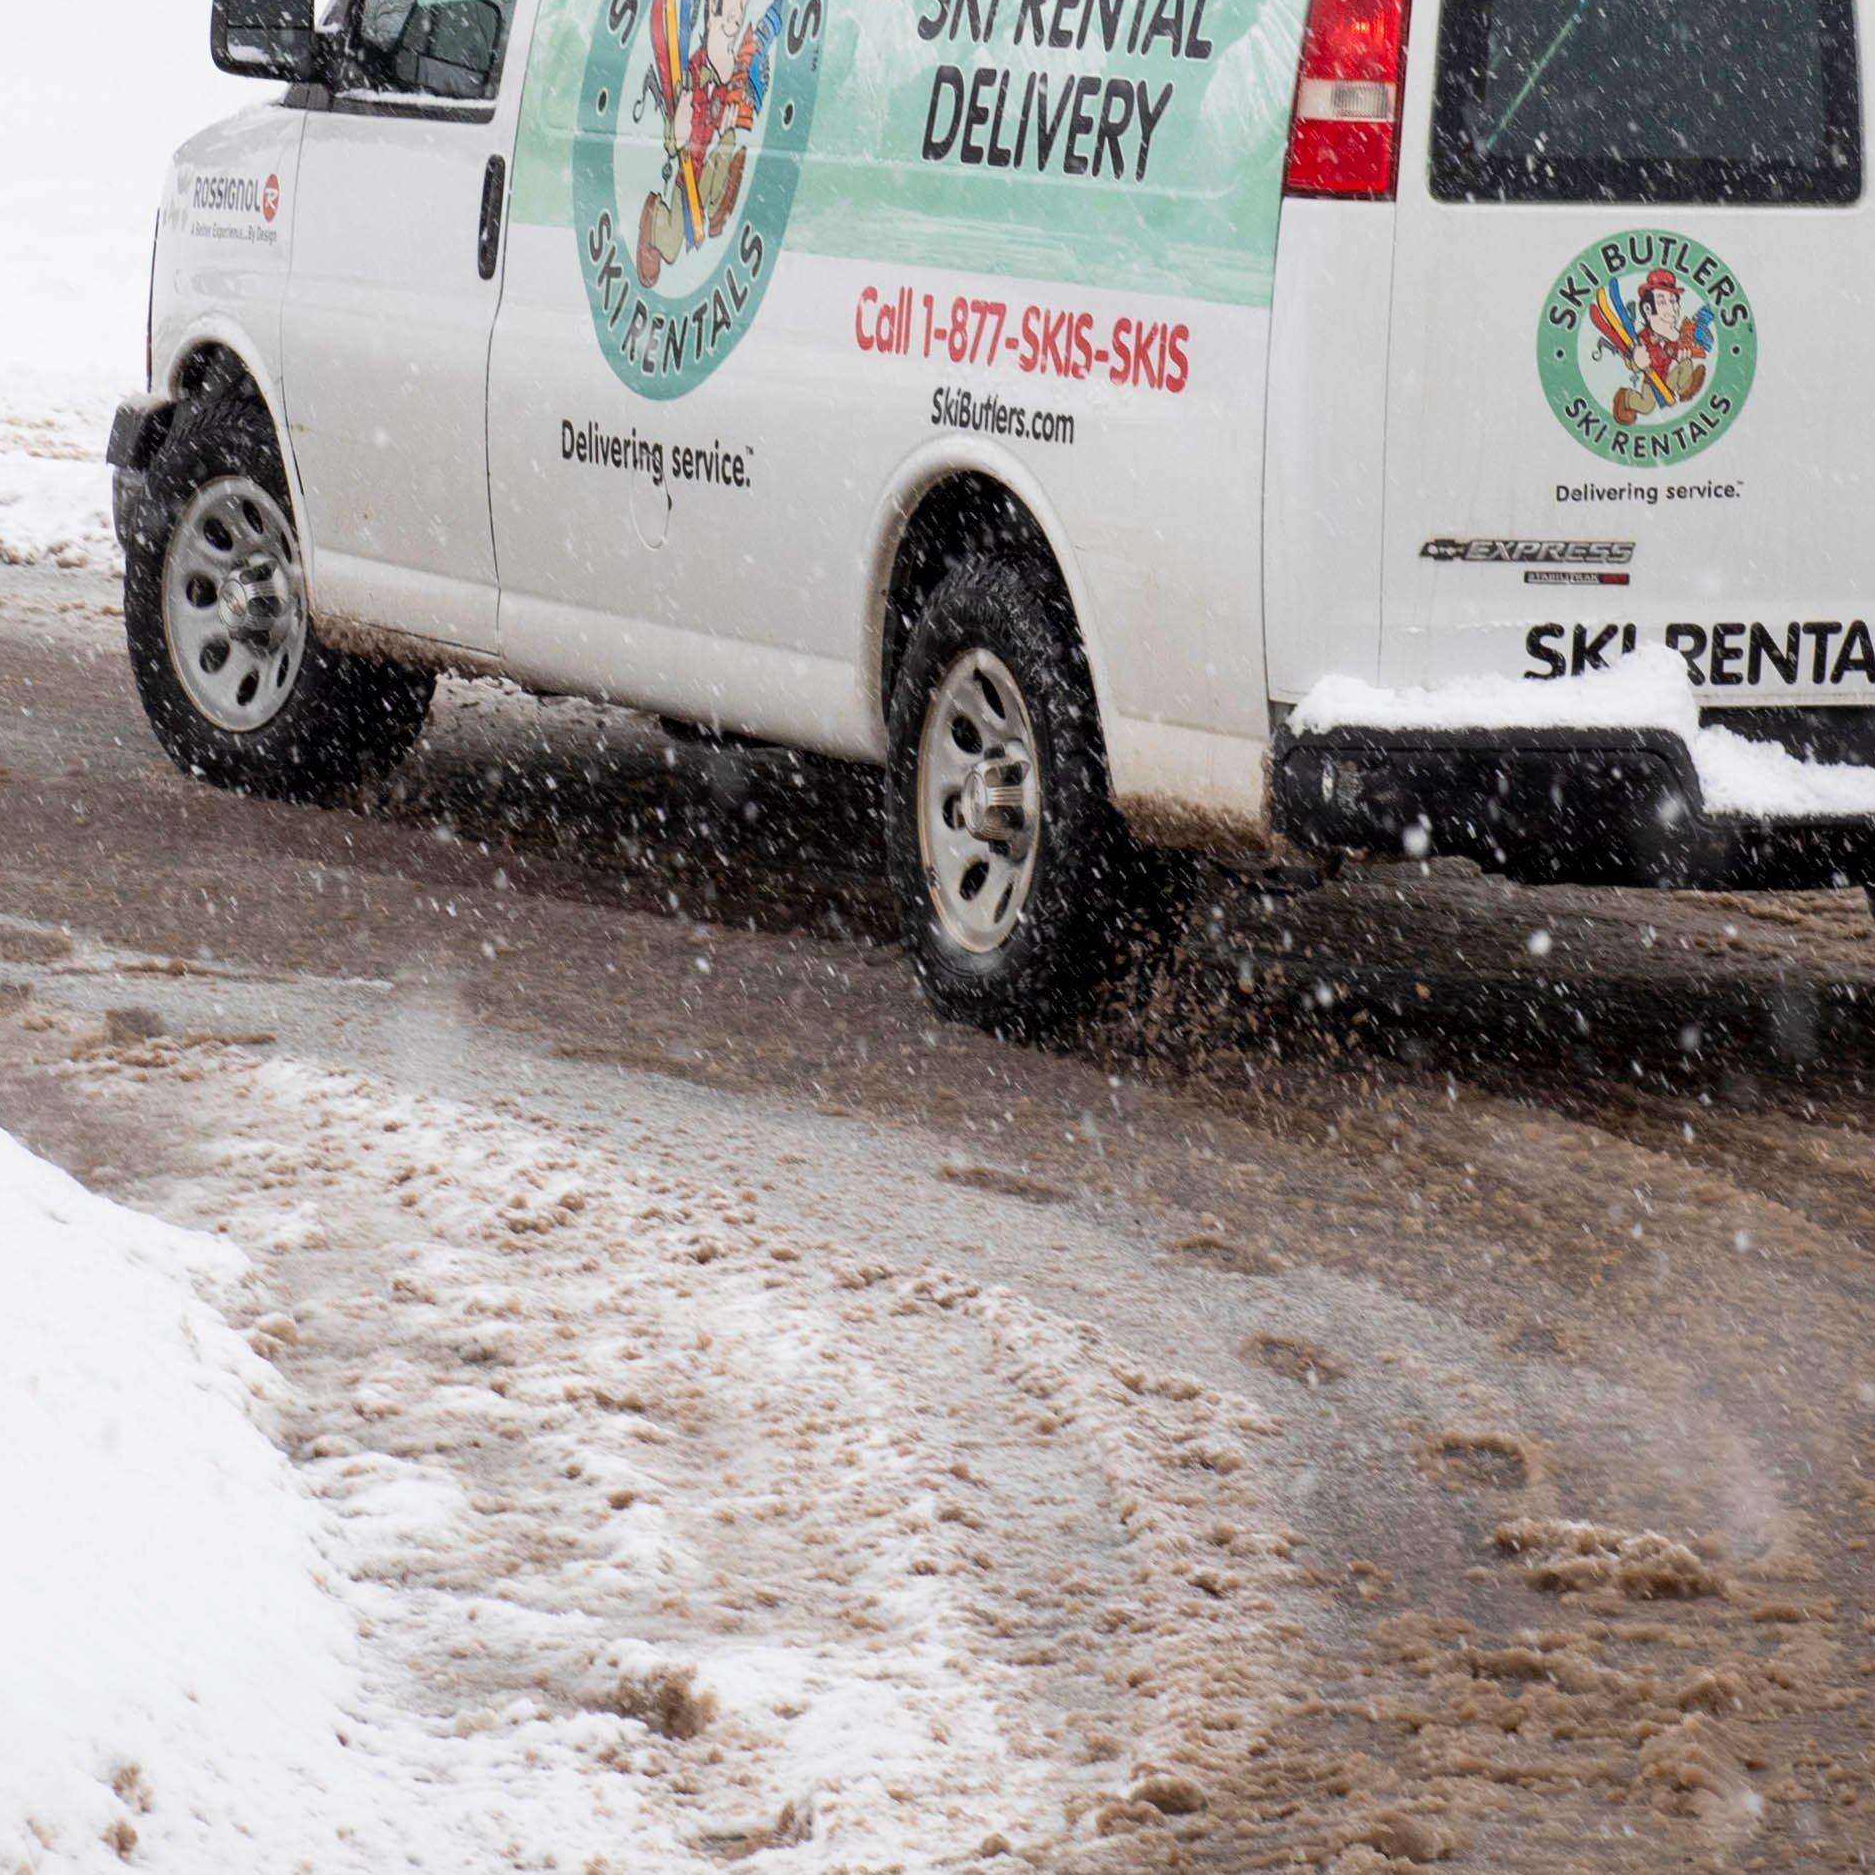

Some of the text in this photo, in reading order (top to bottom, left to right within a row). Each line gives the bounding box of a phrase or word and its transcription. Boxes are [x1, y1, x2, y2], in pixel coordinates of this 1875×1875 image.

[921, 65, 1174, 181] DELIVERY
[193, 175, 261, 213] ROSSIGNOL
[589, 211, 764, 374] SKI RENTALS
[1549, 235, 1748, 330] SKI BUTLERS
[855, 285, 1190, 394] Call 1-877-SKIS-SKIS
[930, 386, 1075, 446] SkiButlers.com
[1564, 394, 1731, 458] SKI RENTALS
[561, 419, 664, 487] Delivering
[1556, 482, 1658, 505] Delivering
[1465, 539, 1636, 564] EXPRESS
[1523, 622, 1637, 680] SKI
